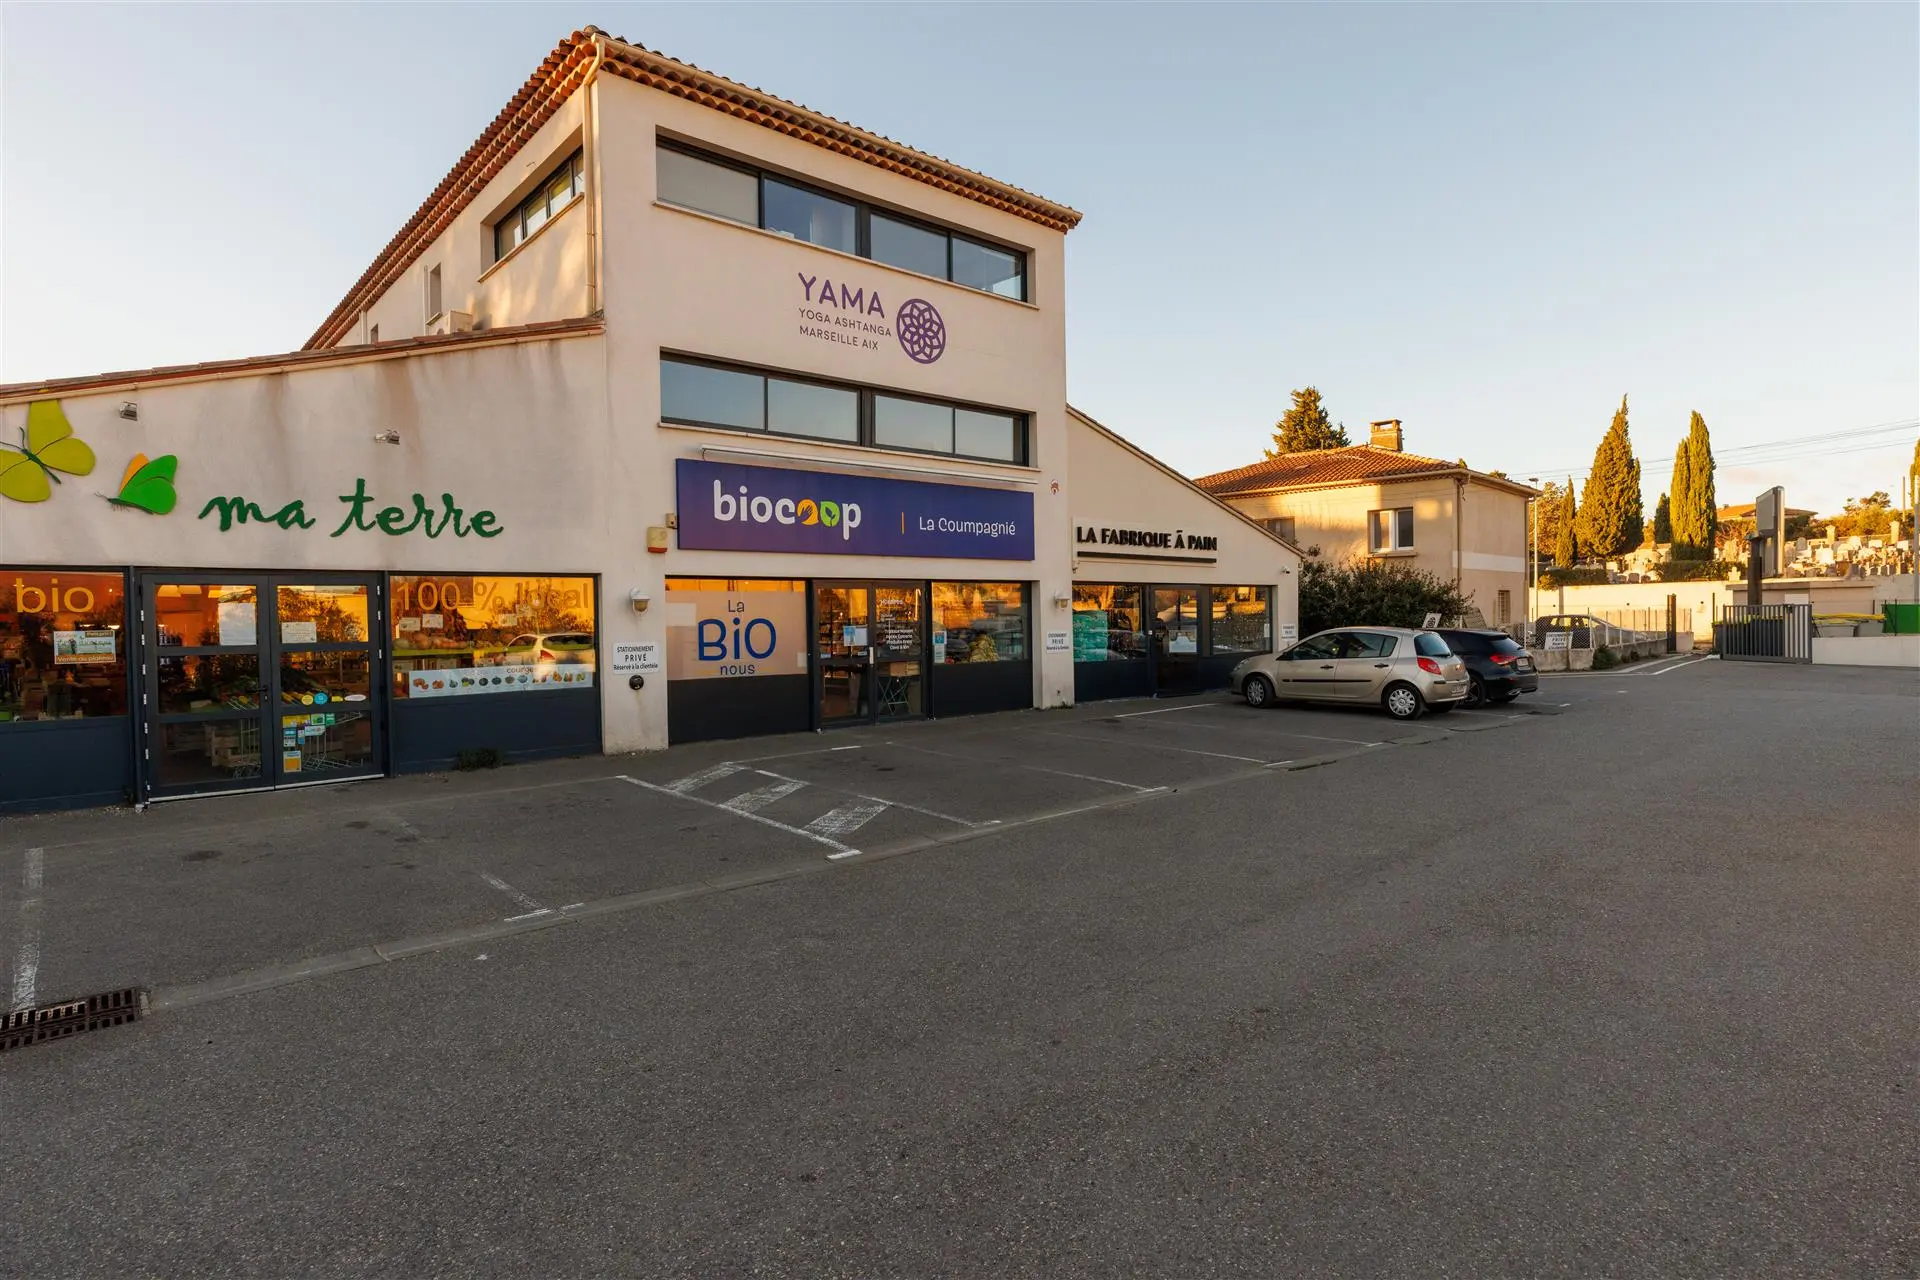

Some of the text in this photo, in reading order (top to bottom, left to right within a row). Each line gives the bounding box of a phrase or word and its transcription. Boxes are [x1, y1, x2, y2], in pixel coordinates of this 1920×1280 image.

[798, 272, 885, 318] YAMA
[798, 307, 892, 337] YOGA ASHTANGA
[799, 325, 879, 350] MARSEILLE AIX
[198, 478, 504, 539] ma terre
[713, 479, 862, 540] biocoop
[919, 516, 1016, 536] La Coumpagnié
[1076, 526, 1098, 543] LA
[1101, 528, 1172, 549] FABRIQUE
[1187, 535, 1217, 551] PAIN
[16, 578, 94, 613] bio
[396, 582, 589, 611] 100 % local
[728, 599, 745, 612] La
[625, 653, 647, 661] PRIVÉ
[720, 664, 755, 675] nous
